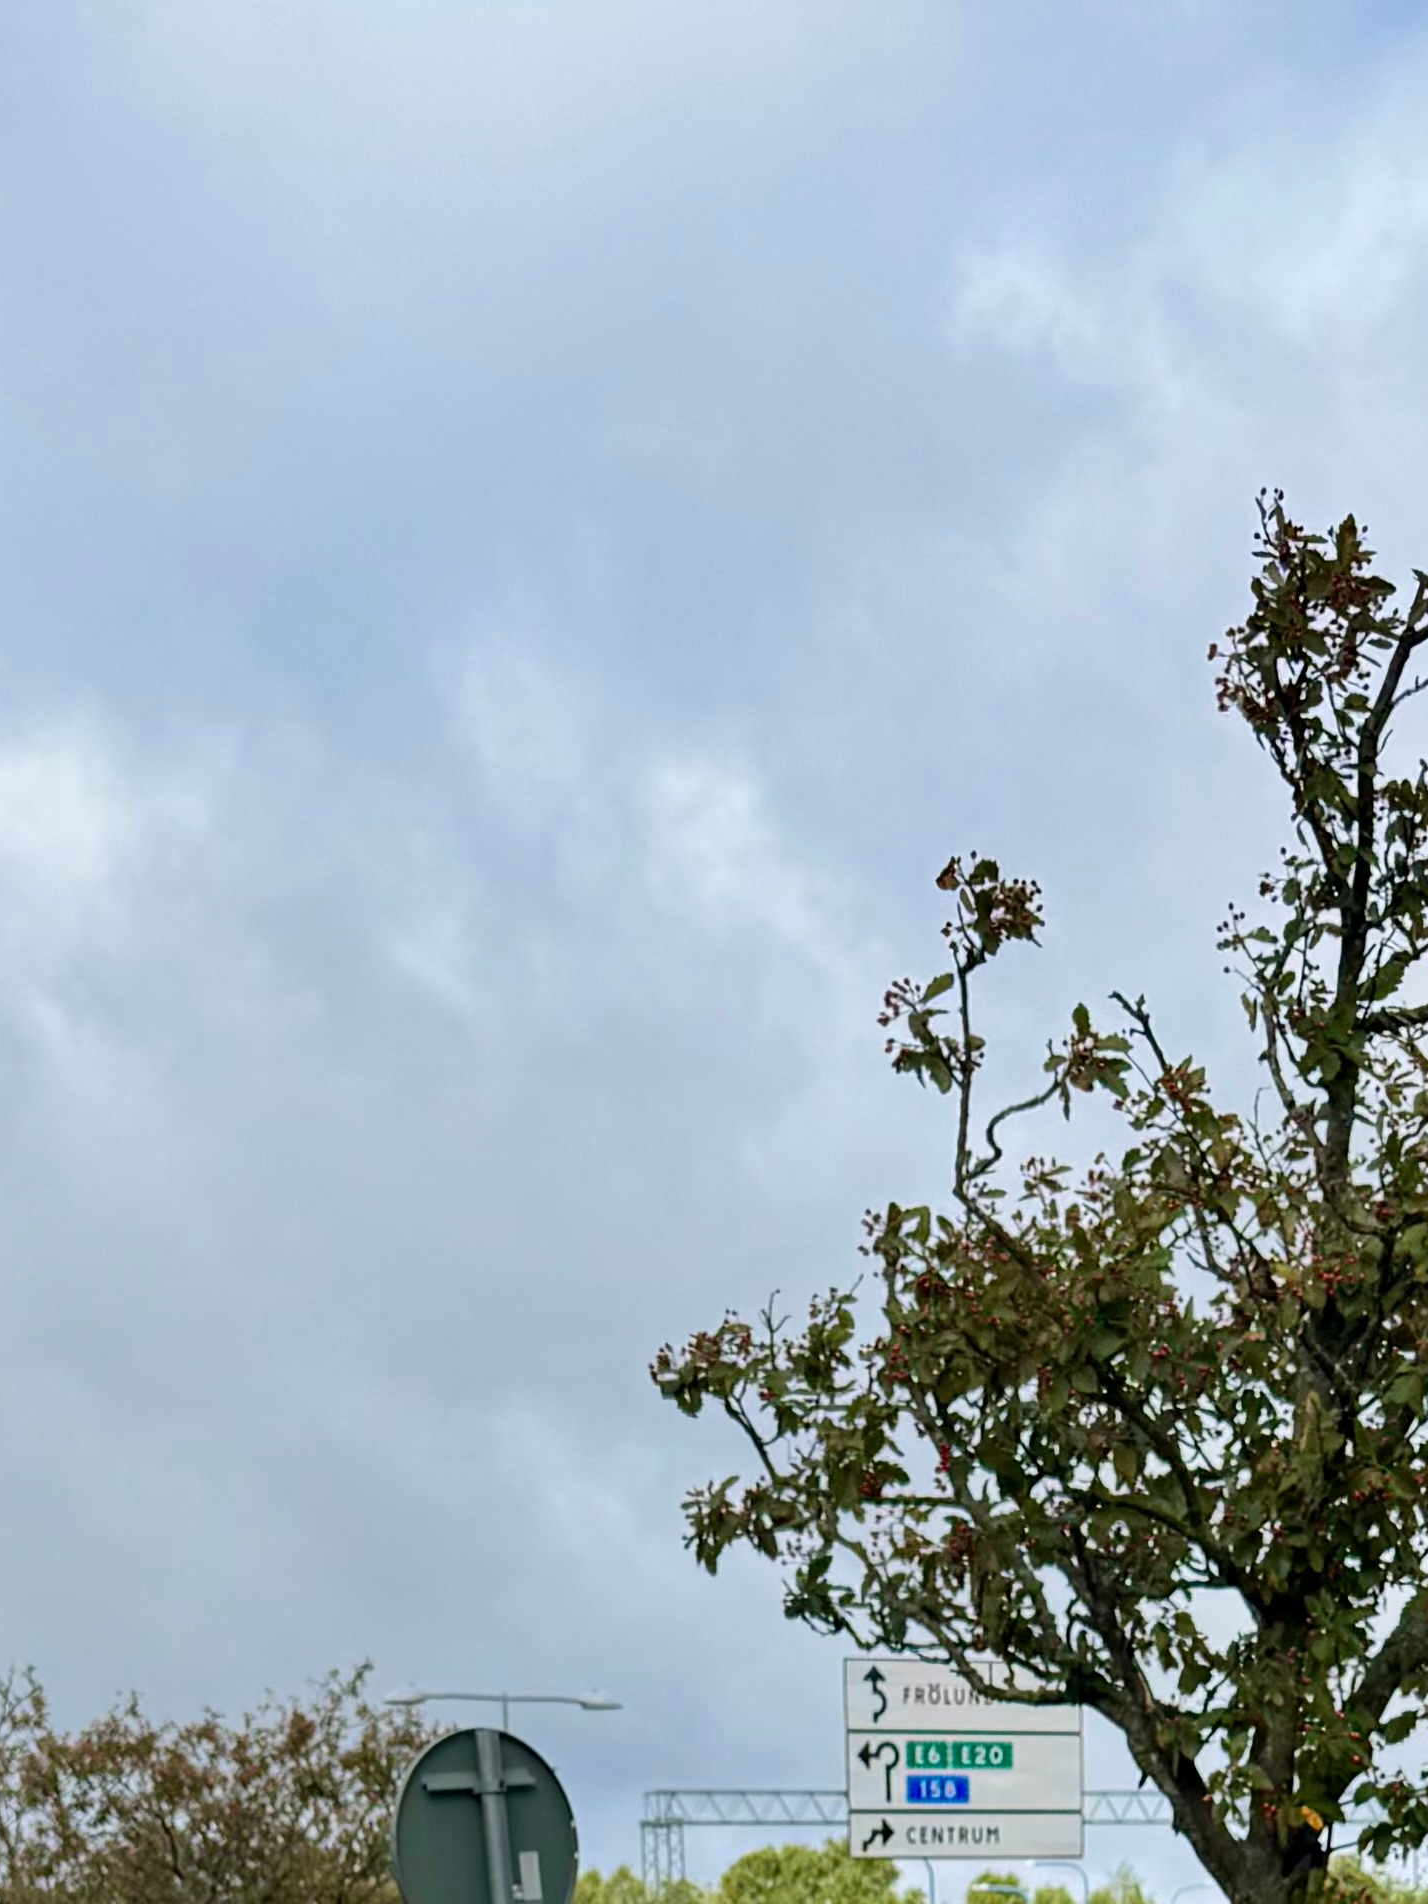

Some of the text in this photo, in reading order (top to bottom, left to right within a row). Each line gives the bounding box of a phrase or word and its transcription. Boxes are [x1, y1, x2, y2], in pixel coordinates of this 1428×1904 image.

[903, 1683, 1004, 1706] FRÖLUN
[915, 1746, 1004, 1764] E6 E20
[906, 1826, 1001, 1845] CENTRUM
